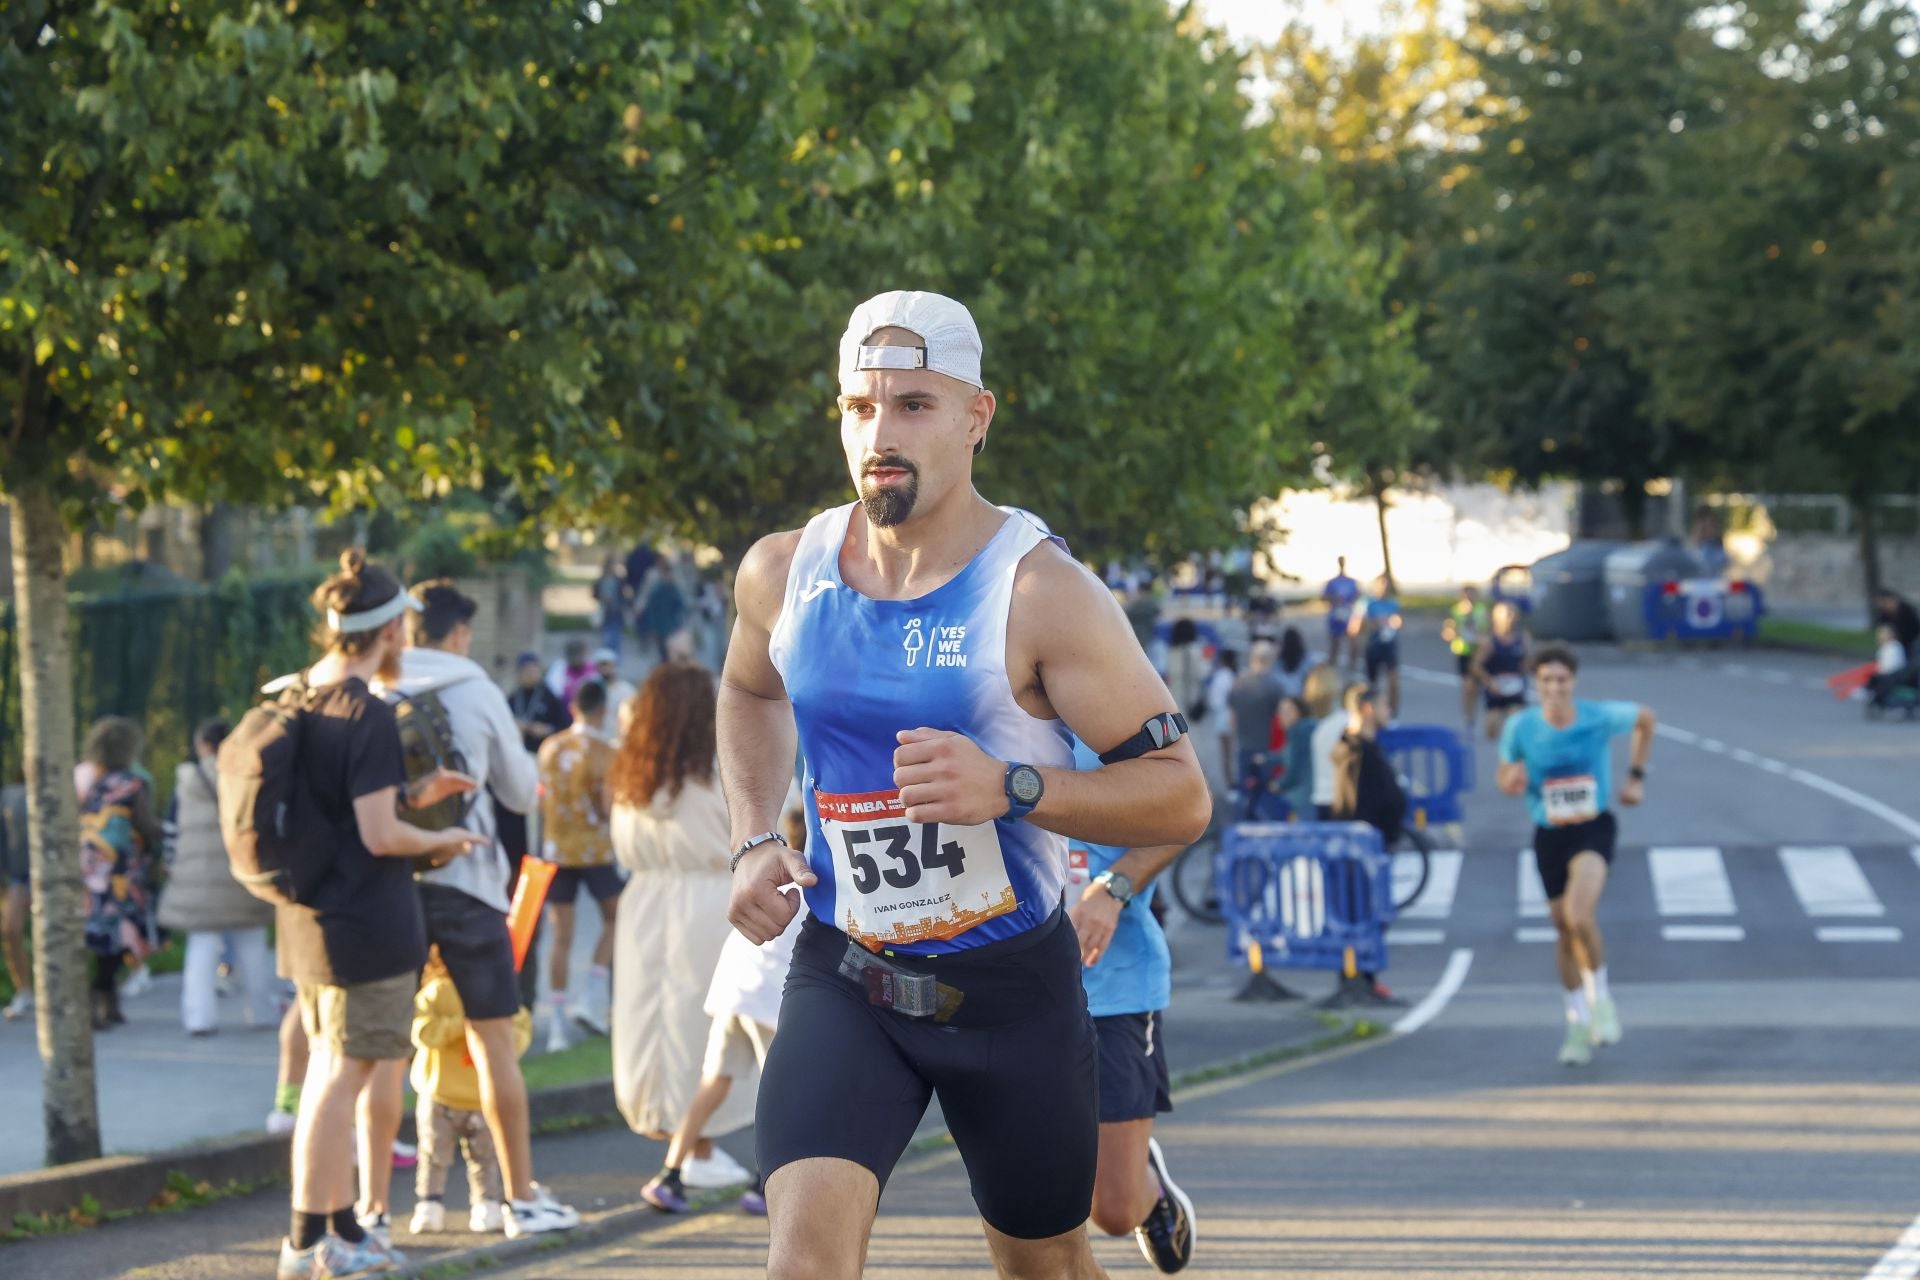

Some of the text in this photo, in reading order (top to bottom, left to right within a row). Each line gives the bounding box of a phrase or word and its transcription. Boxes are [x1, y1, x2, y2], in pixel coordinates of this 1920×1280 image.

[940, 626, 966, 638] YES
[938, 640, 961, 653] WE
[936, 654, 967, 667] RUN
[850, 800, 886, 814] MBA
[841, 823, 966, 895] 534
[873, 893, 952, 914] IVAN GONZALEZ
